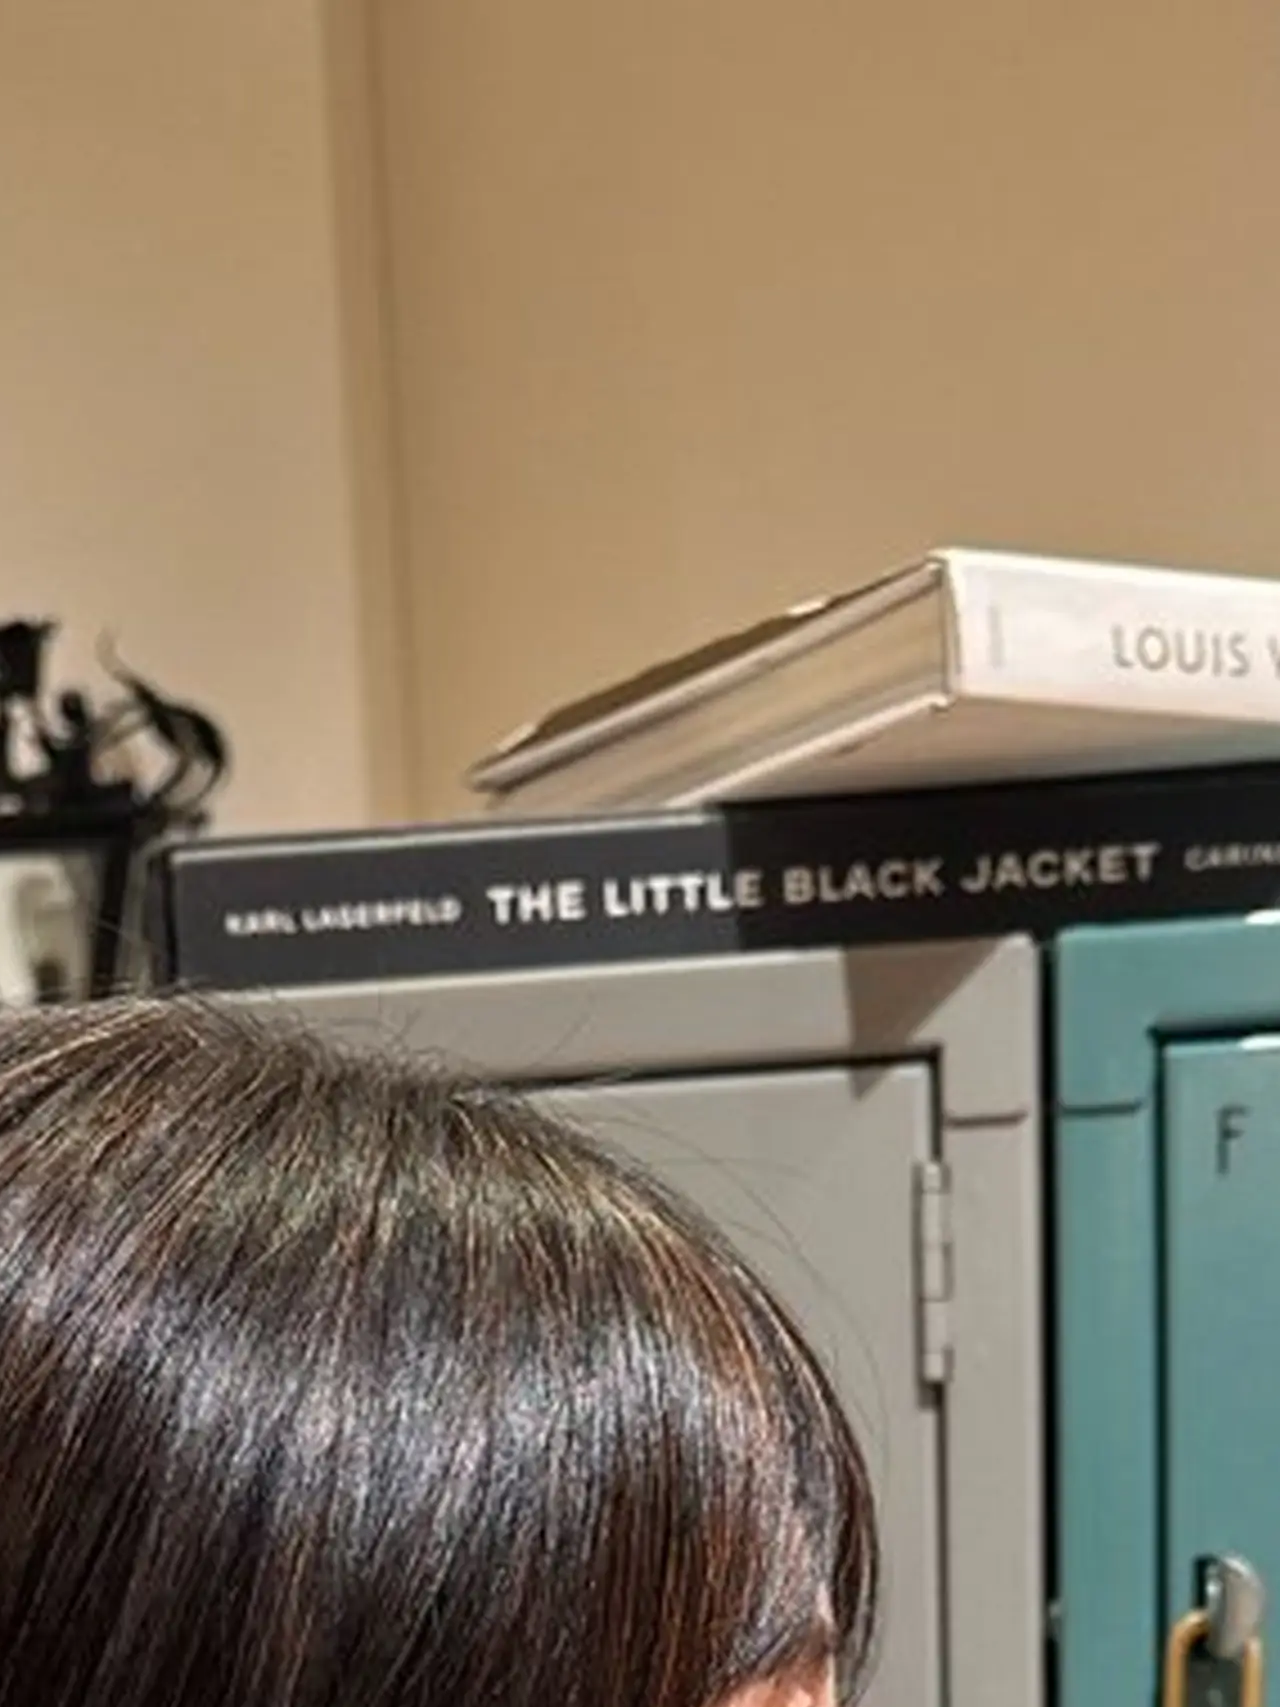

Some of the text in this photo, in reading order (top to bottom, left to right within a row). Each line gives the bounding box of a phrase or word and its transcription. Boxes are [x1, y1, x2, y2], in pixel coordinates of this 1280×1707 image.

[1109, 623, 1252, 679] LOUIS
[224, 905, 297, 937] KARL
[486, 878, 587, 926] THE
[603, 868, 765, 919] LITTLE
[781, 854, 947, 905] BLACK
[960, 840, 1161, 894] JACKET
